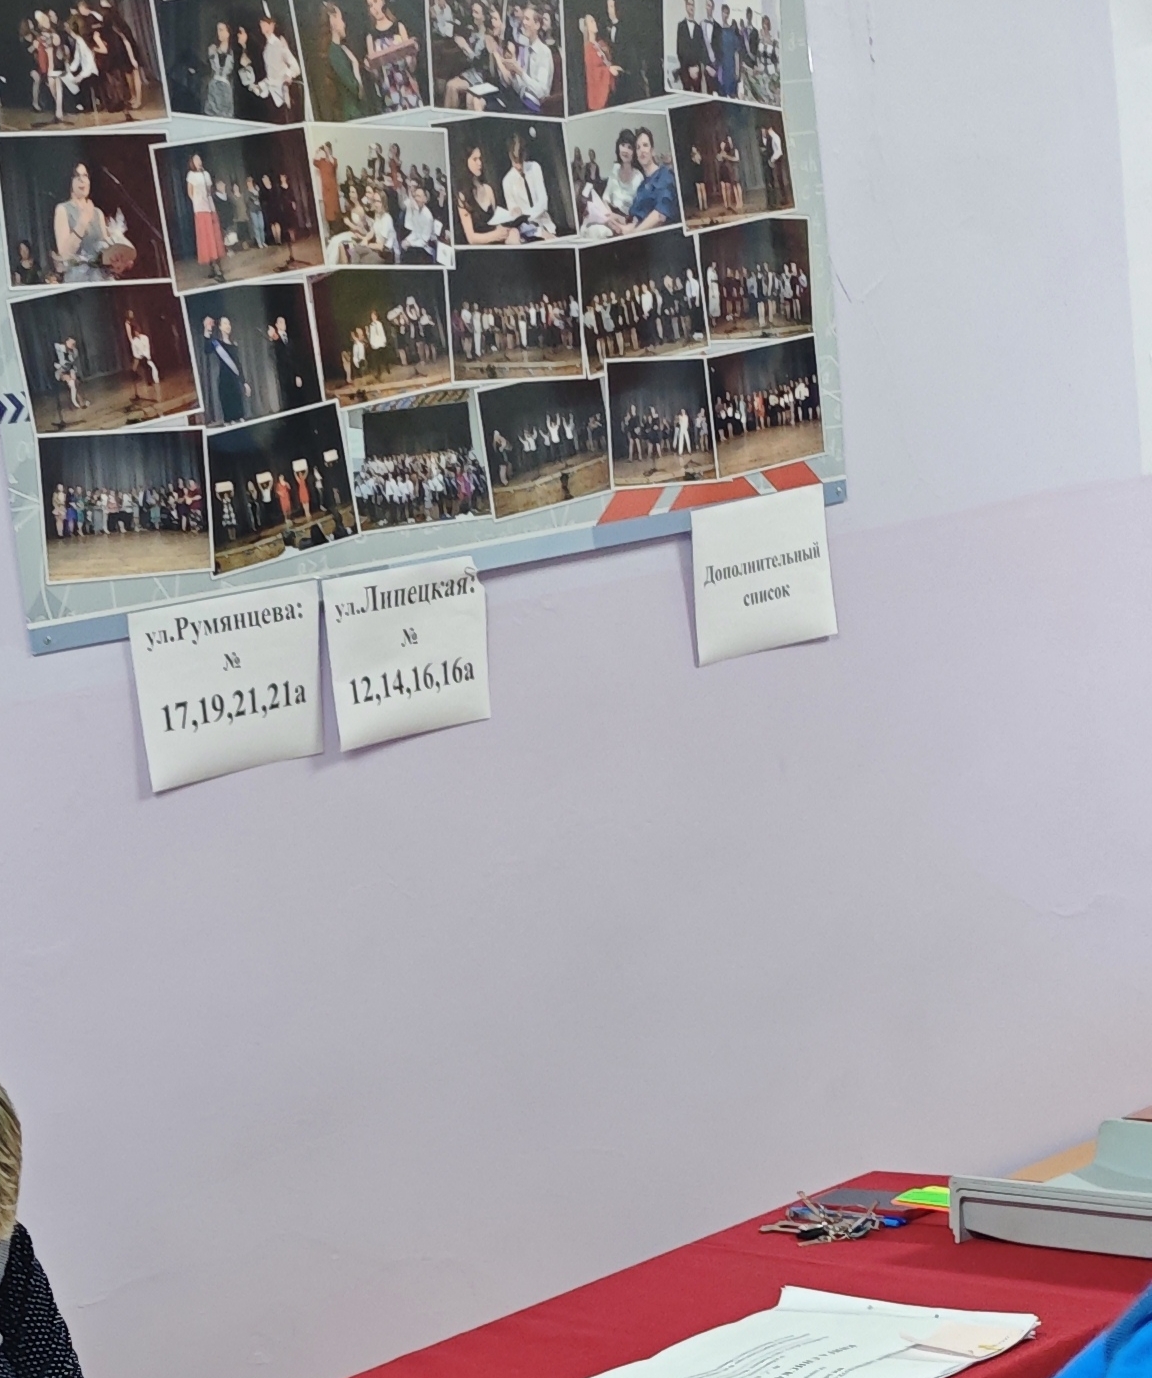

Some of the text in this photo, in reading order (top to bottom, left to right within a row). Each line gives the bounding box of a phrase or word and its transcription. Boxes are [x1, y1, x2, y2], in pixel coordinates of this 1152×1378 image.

[704, 541, 821, 588] Дополнительный
[743, 584, 791, 607] список
[145, 602, 304, 652] ул.Румянцева:
[400, 627, 419, 648] №
[222, 652, 242, 672] №
[348, 656, 475, 706] 12,14,16,16а
[160, 680, 307, 733] 17,19,21,21а
